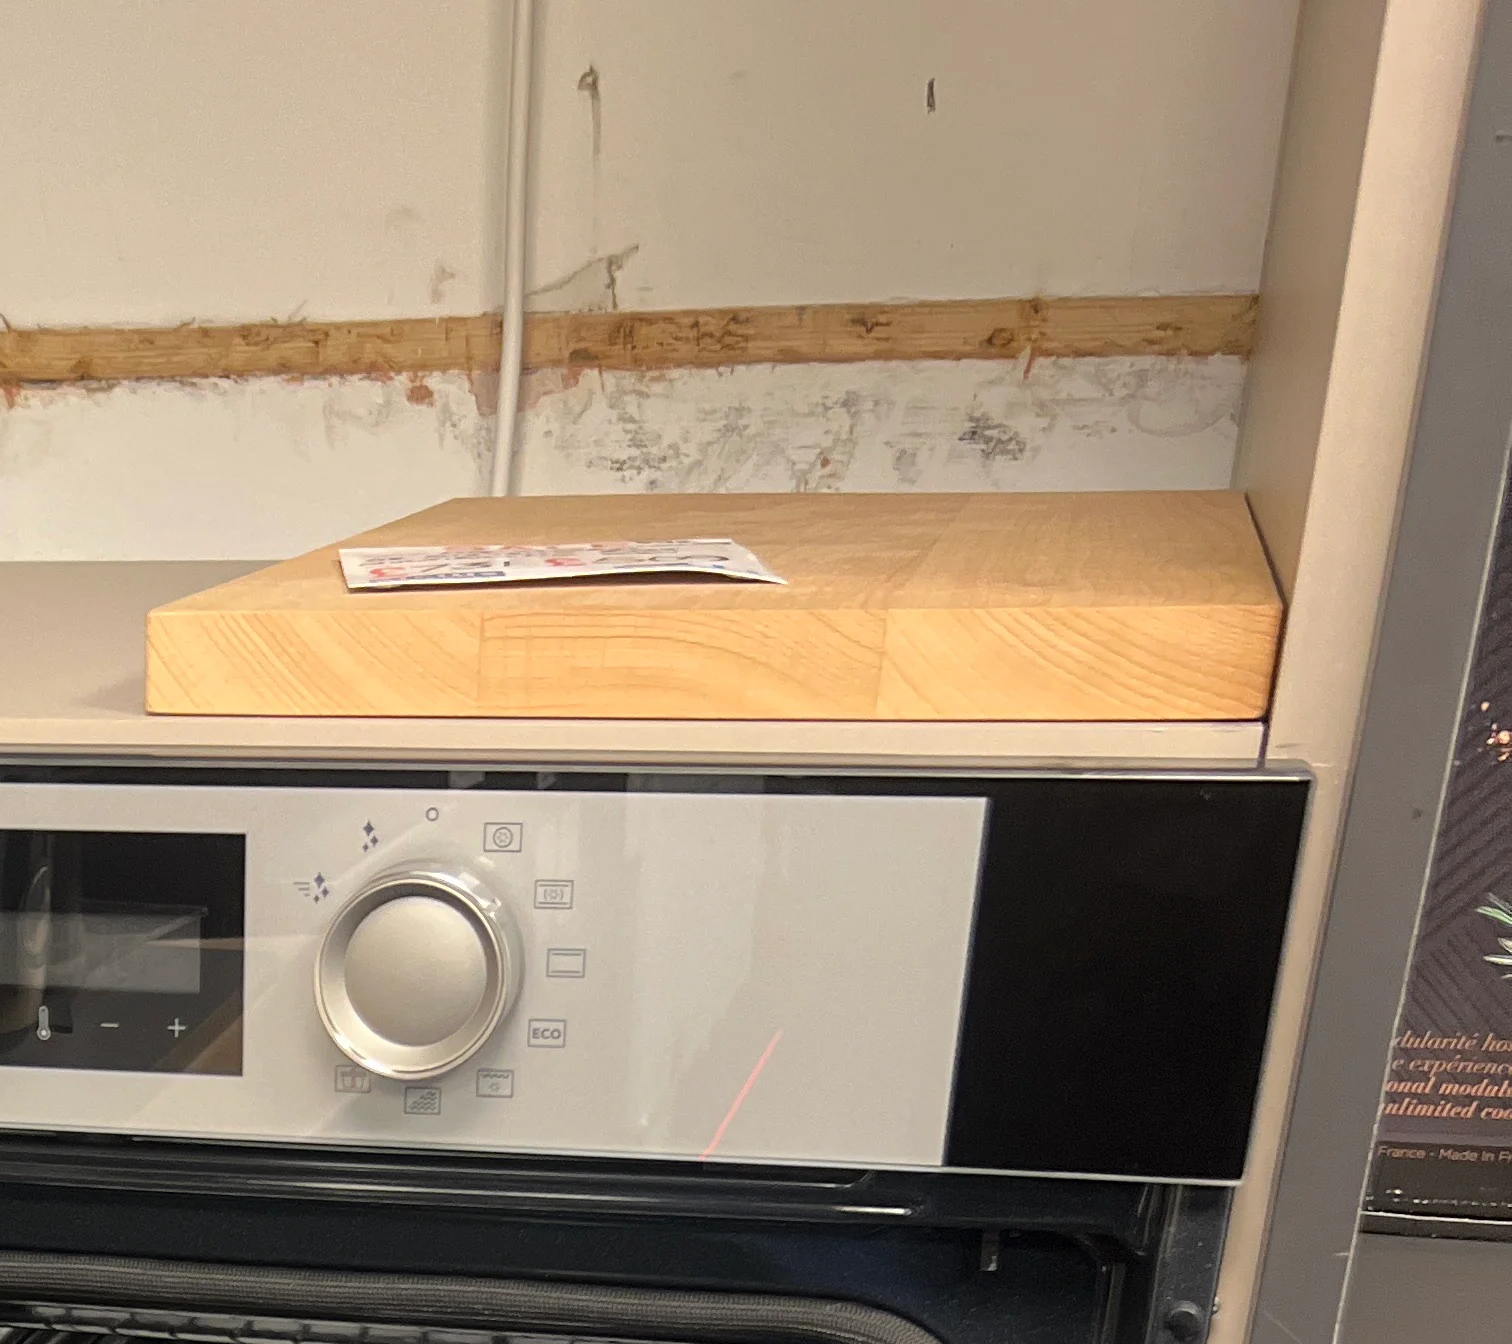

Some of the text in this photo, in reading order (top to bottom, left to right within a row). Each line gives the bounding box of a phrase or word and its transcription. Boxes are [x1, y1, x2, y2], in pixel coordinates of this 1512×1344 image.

[531, 1027, 563, 1041] ECO
[1377, 1145, 1427, 1160] France
[1439, 1148, 1479, 1162] Made
